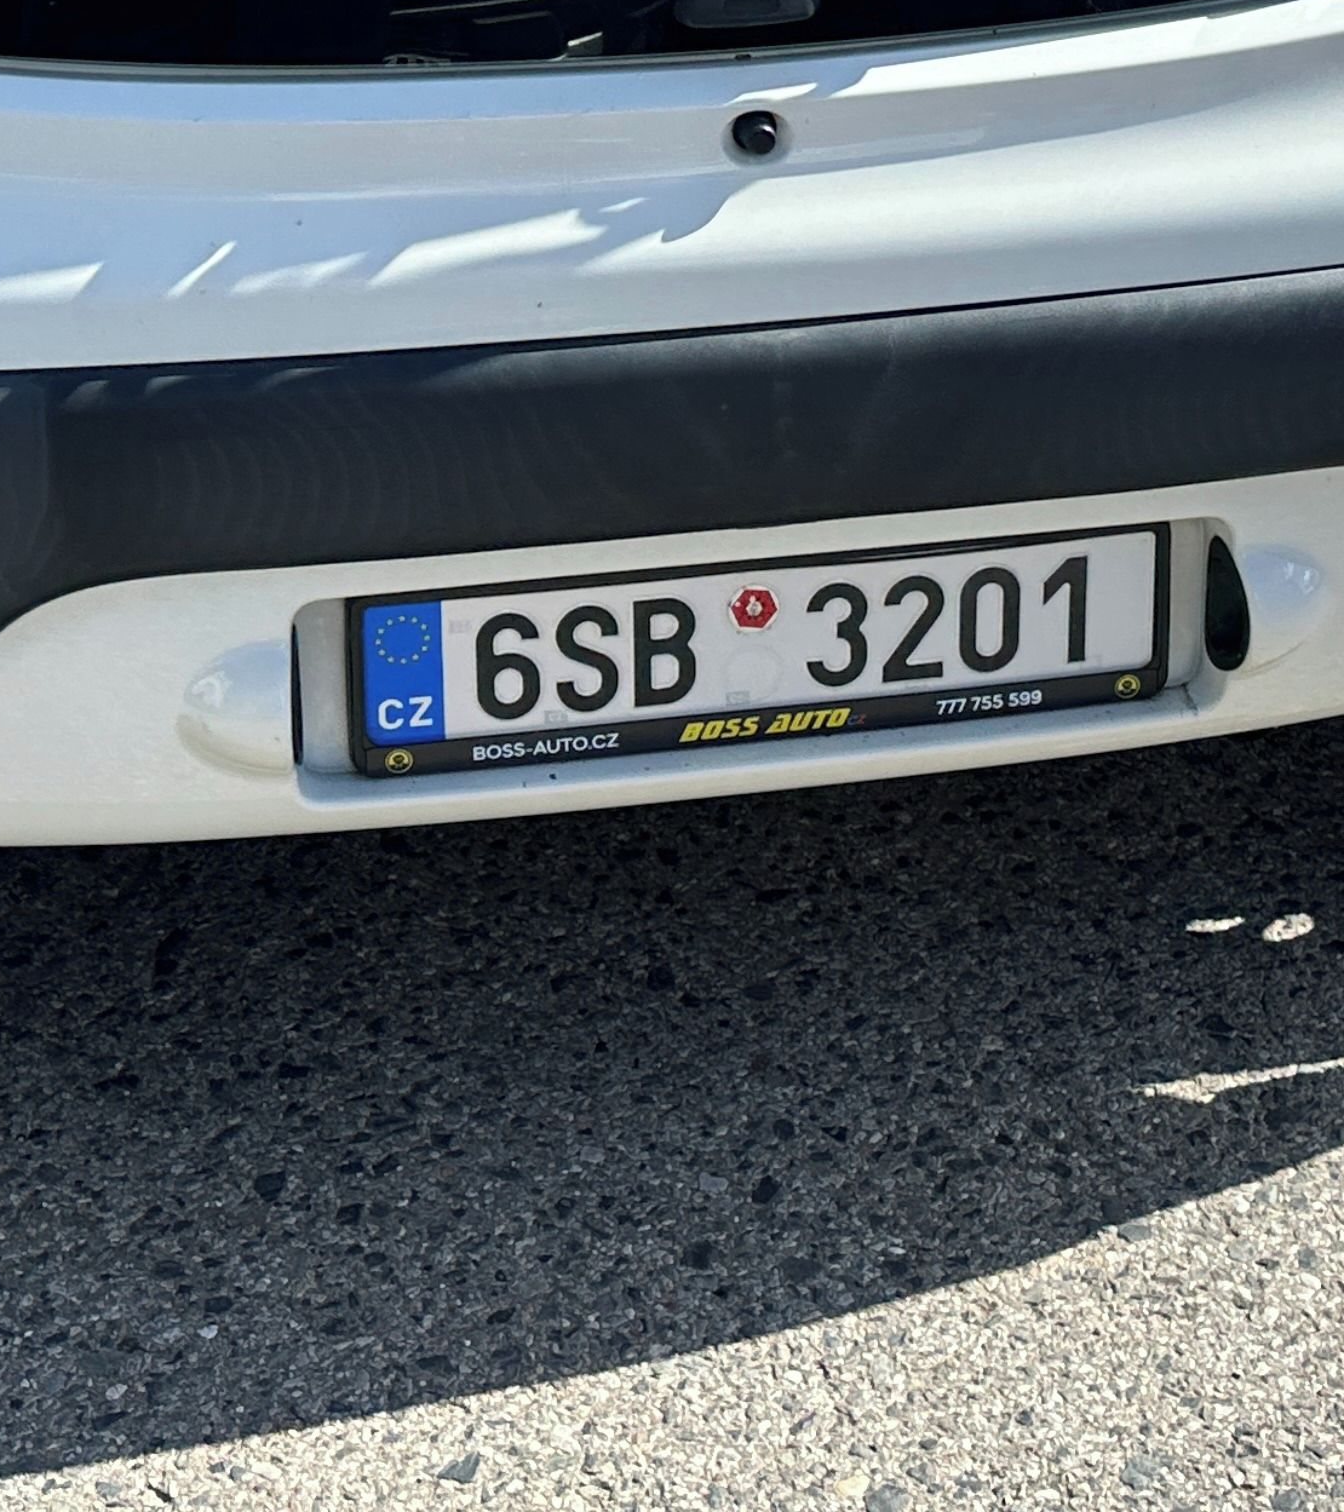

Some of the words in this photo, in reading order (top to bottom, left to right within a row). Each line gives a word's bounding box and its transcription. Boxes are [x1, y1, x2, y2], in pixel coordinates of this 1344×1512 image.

[475, 596, 697, 721] 6SB
[805, 555, 1089, 688] 3201
[377, 695, 433, 730] CZ
[936, 697, 967, 716] 777
[971, 693, 1005, 712] 755
[1008, 690, 1043, 708] 599
[678, 716, 759, 744] BOSS
[764, 706, 852, 735] AUTO
[472, 733, 620, 762] BOSS-AUTO.CZ
